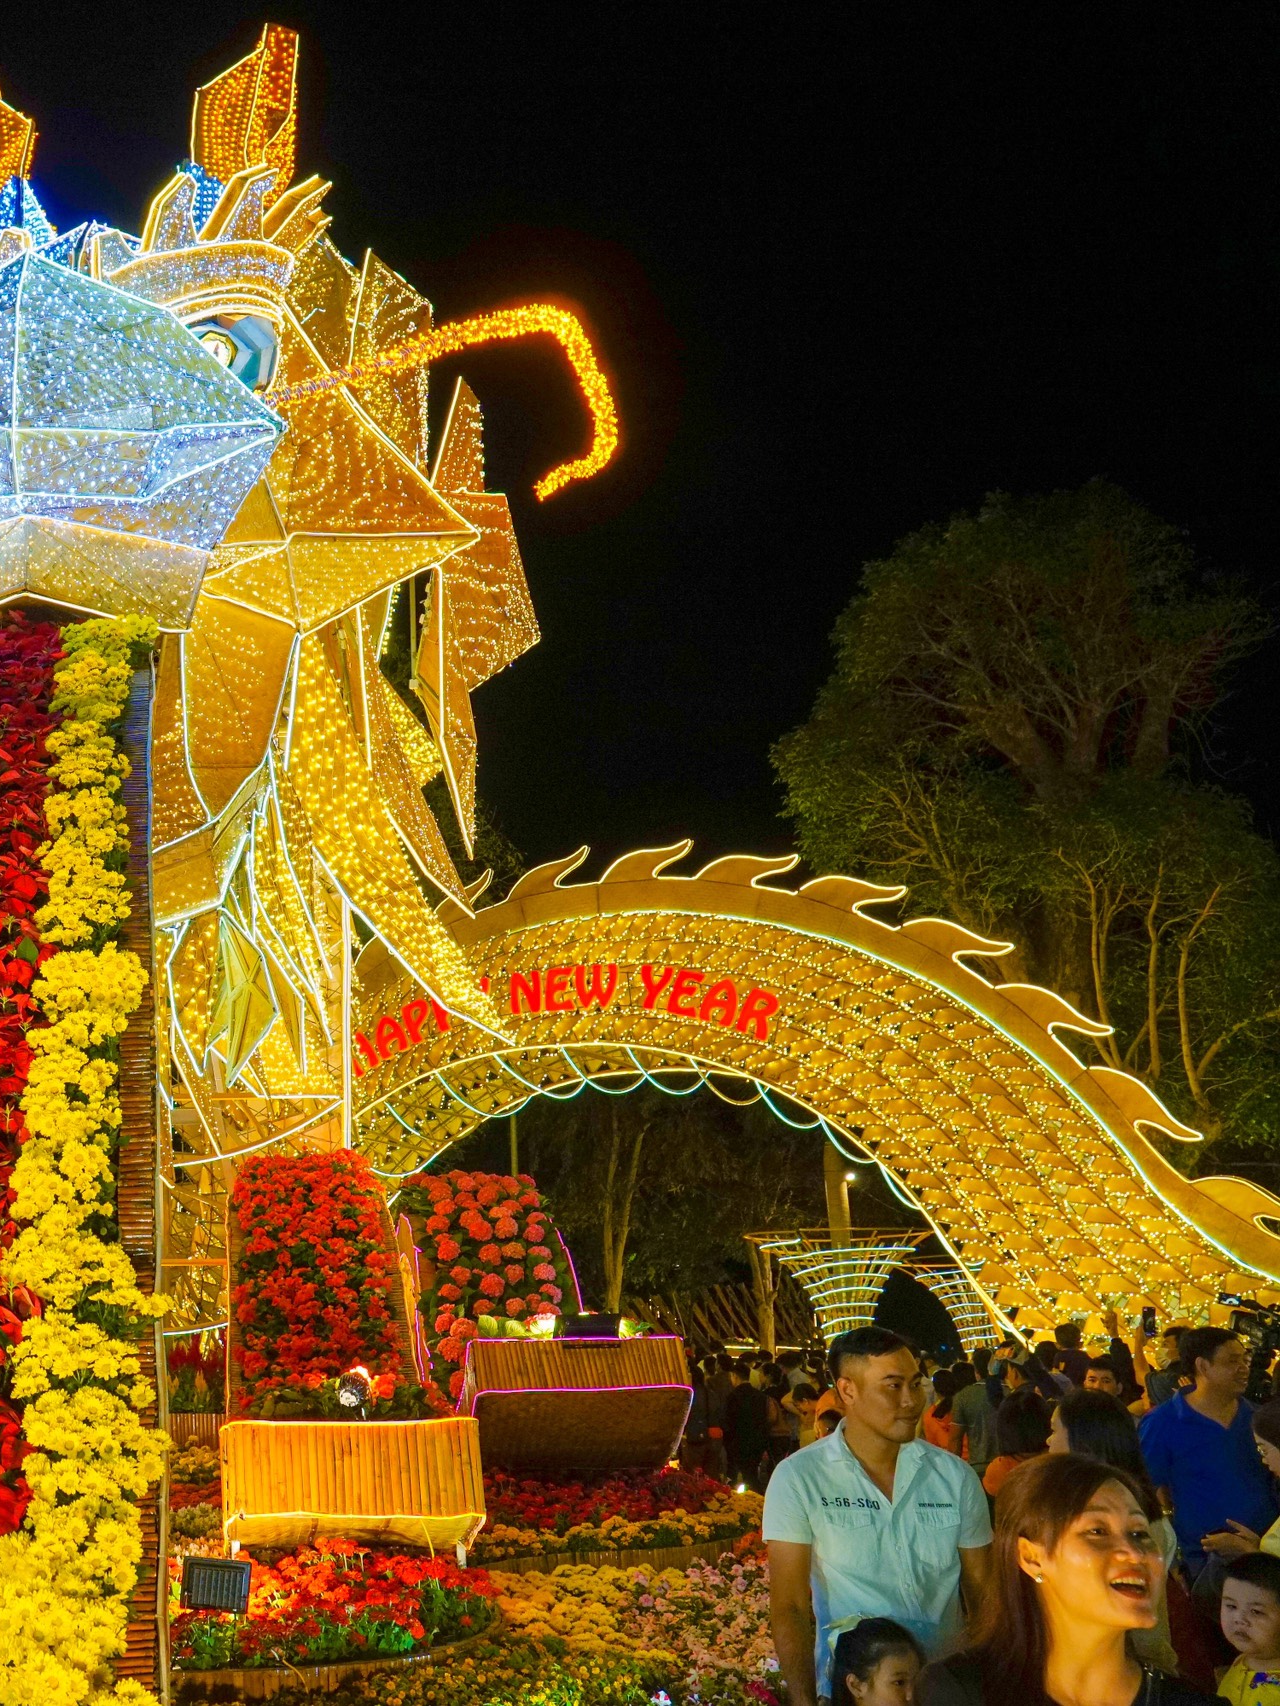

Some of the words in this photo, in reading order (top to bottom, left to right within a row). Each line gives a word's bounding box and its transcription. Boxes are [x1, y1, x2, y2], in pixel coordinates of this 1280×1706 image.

[352, 976, 490, 1078] HAP
[509, 963, 618, 1015] NEW
[639, 963, 780, 1042] YEAR
